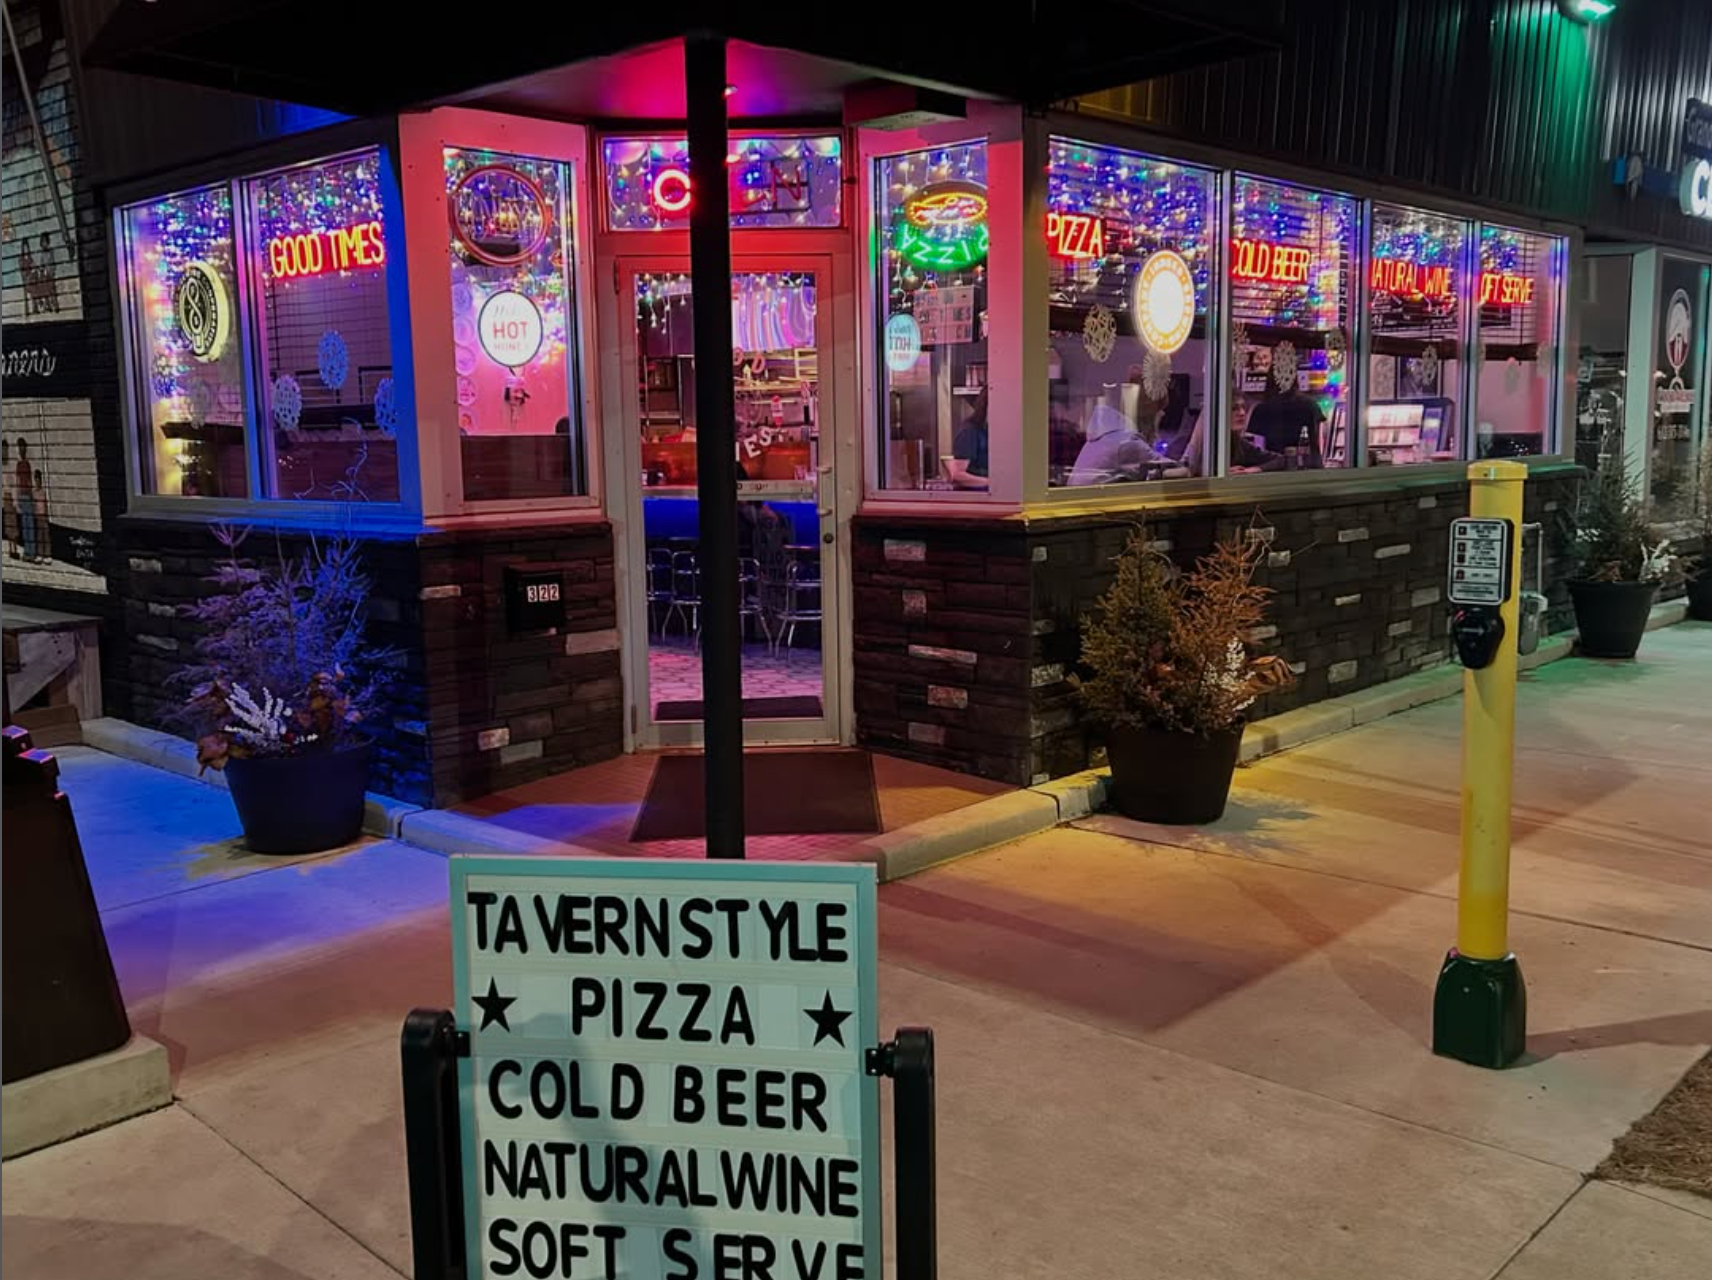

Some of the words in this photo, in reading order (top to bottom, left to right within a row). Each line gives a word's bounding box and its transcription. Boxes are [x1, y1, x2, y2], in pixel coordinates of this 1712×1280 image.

[270, 234, 322, 277] GOOD
[327, 221, 385, 270] TIMES
[1047, 212, 1103, 258] PIZZA
[1271, 245, 1311, 282] BEER
[1424, 267, 1452, 296] WINE
[1479, 272, 1500, 303] OFT
[1501, 275, 1534, 304] SERVE
[492, 320, 529, 340] HOT
[528, 585, 560, 602] 322
[571, 976, 756, 1047] PIZZA
[488, 1059, 645, 1121] COLD
[673, 1064, 828, 1133] BEER
[488, 1218, 626, 1280] SOFT
[662, 1227, 864, 1280] SERVE
